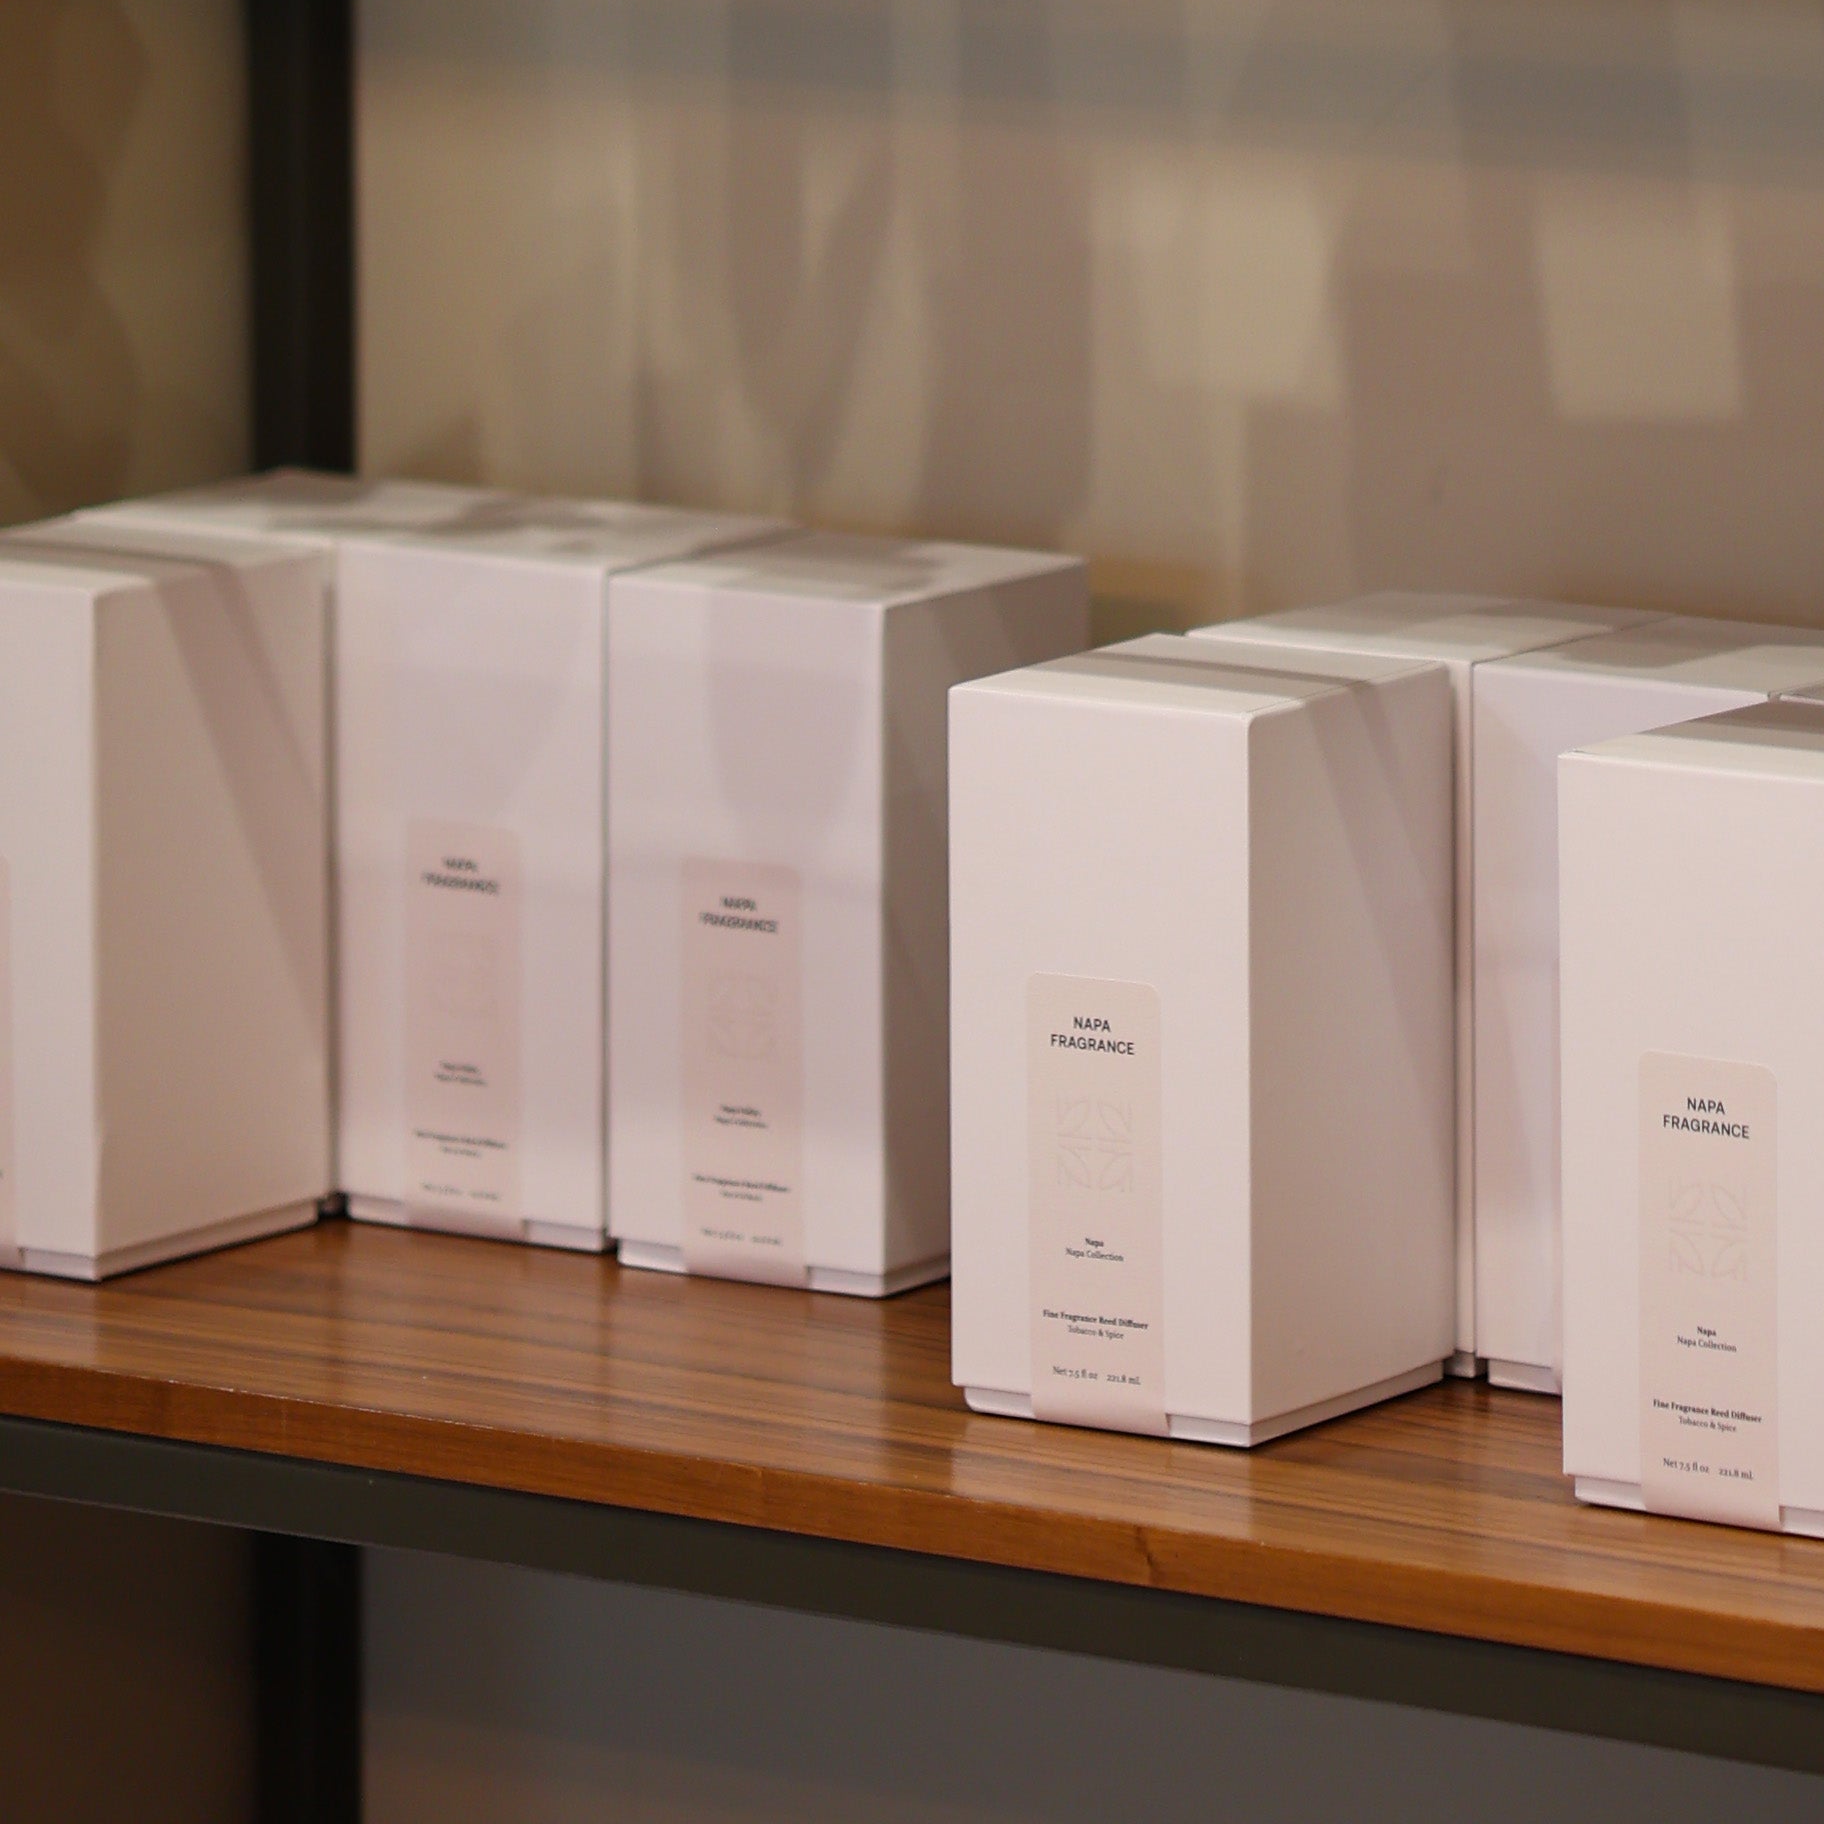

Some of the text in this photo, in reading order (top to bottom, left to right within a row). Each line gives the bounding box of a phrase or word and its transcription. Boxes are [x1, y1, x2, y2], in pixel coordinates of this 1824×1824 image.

[1073, 1016, 1111, 1033] NAPA
[1050, 1033, 1135, 1056] FRAGRANCE
[1687, 1096, 1726, 1115] NAPA
[1662, 1114, 1750, 1140] FRAGRANCE
[1060, 1311, 1097, 1323] Fragrance
[1697, 1326, 1717, 1337] Napa
[1677, 1335, 1737, 1352] Napa Collection
[1053, 1366, 1067, 1377] Net
[1653, 1398, 1762, 1423] Fine Fragrance Reed Diffuser
[1679, 1415, 1708, 1428] Tobacco
[1717, 1422, 1737, 1433] Spice
[1663, 1457, 1678, 1469] Net
[1679, 1462, 1691, 1472] 7.5
[1700, 1465, 1709, 1473] oz
[1719, 1466, 1740, 1477] 221.8
